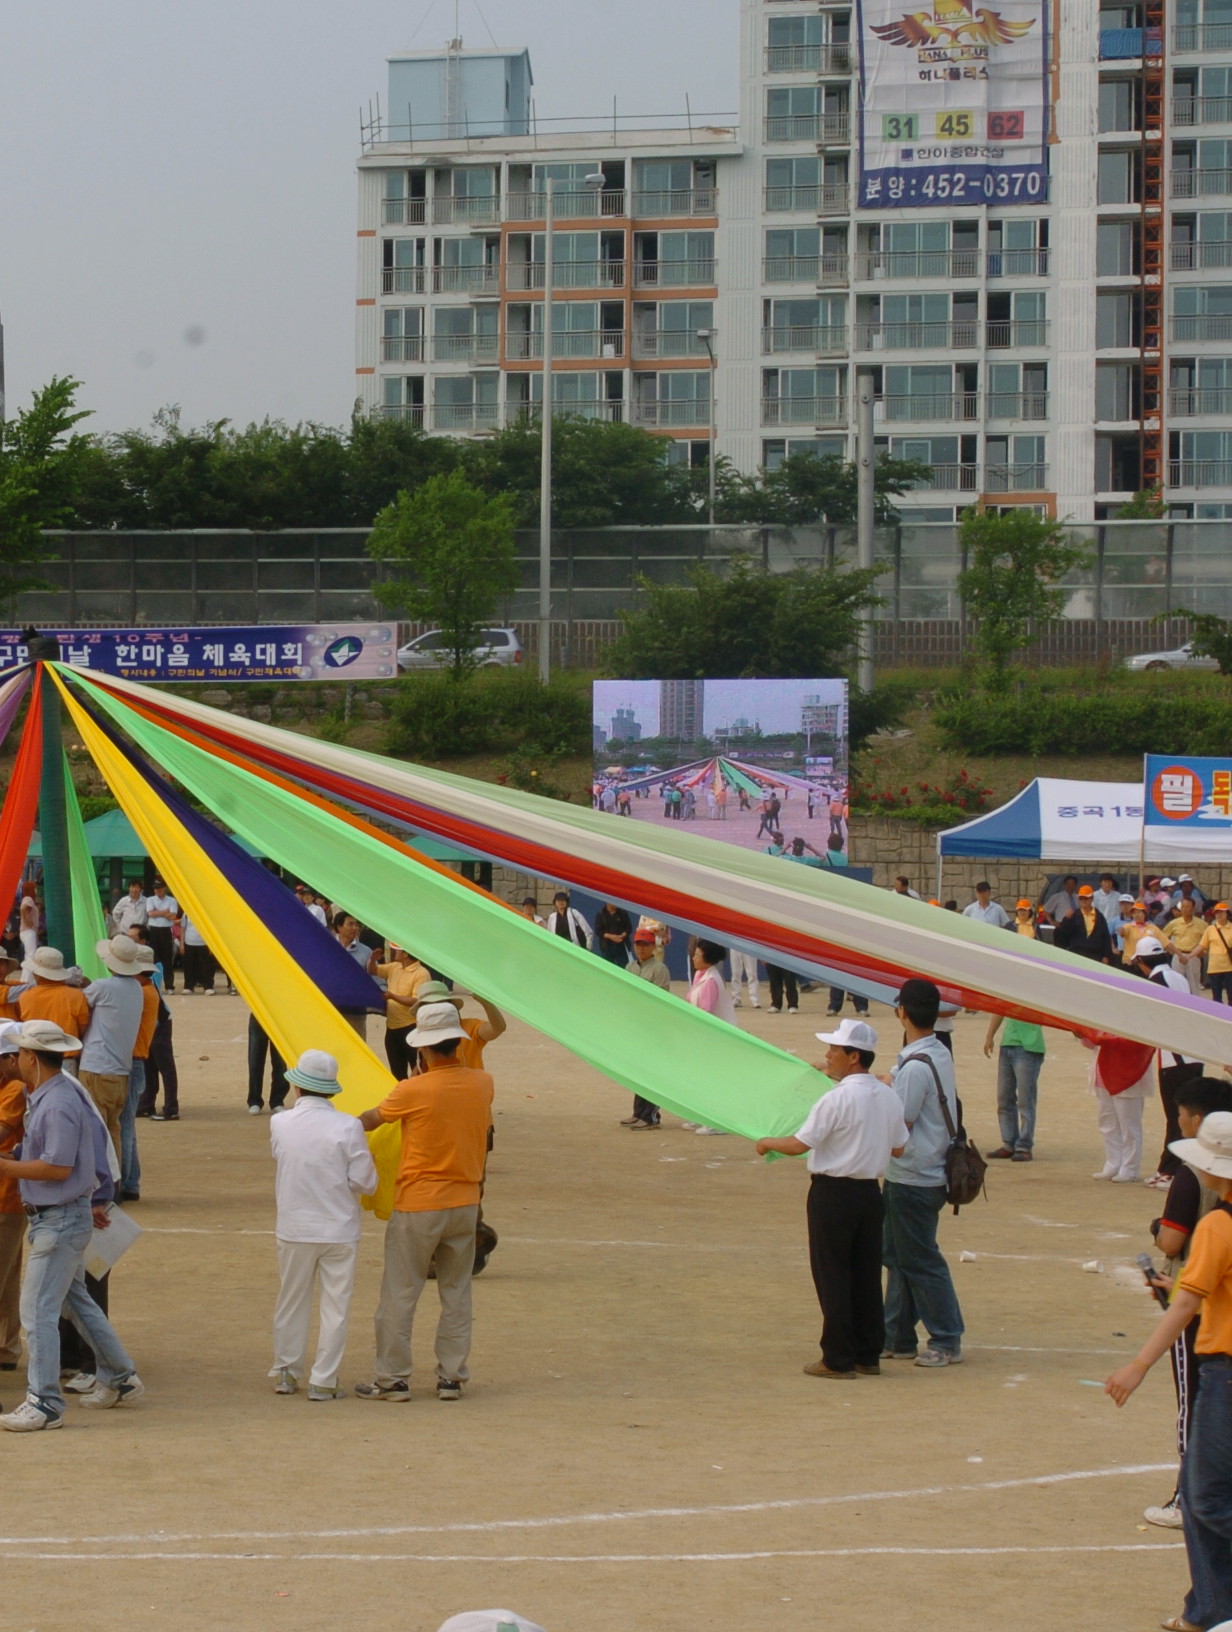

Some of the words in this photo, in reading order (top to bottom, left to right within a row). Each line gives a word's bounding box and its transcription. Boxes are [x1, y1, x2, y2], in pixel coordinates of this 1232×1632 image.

[960, 47, 989, 58] PLUS
[887, 117, 914, 139] 31
[941, 115, 969, 136] 45
[991, 115, 1020, 136] 62
[114, 644, 190, 667] 한마음
[202, 643, 303, 667] 체육대회
[1160, 773, 1194, 812] 필
